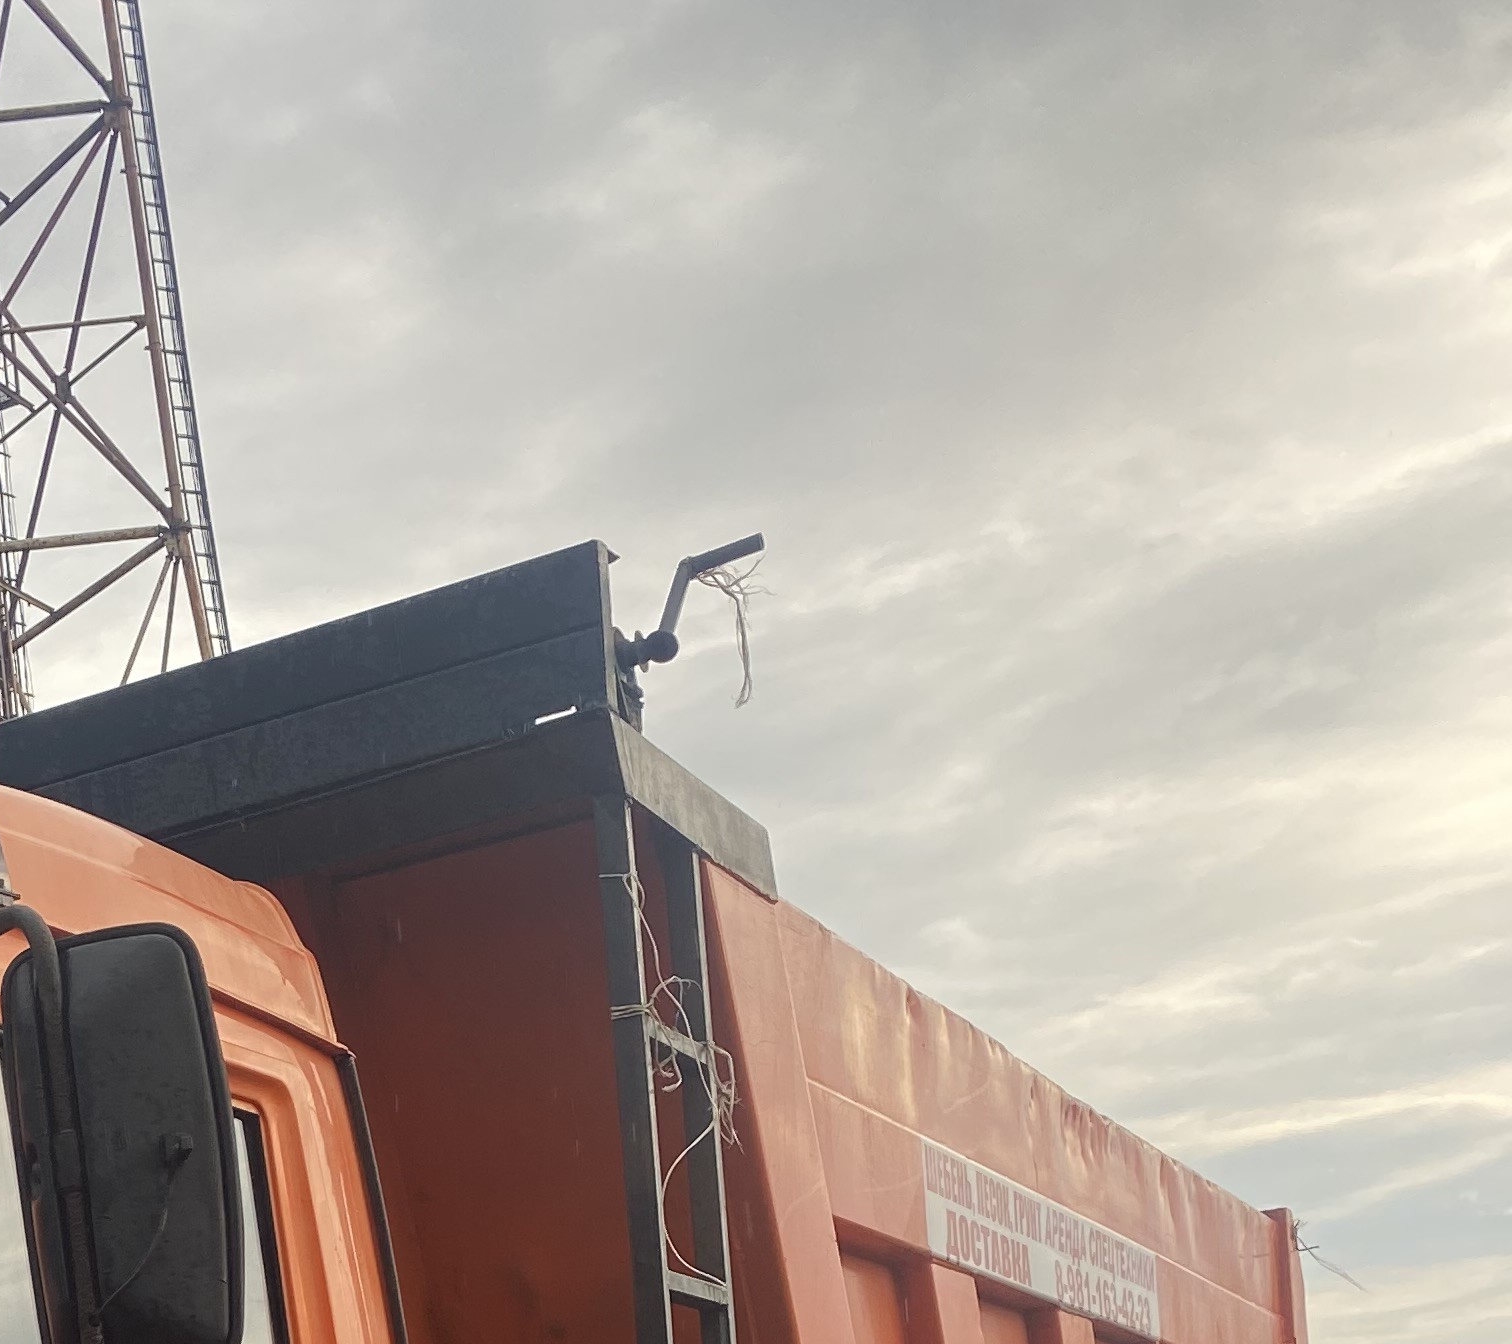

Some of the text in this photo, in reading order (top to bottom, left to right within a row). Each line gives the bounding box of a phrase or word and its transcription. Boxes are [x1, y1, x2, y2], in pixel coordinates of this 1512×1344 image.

[946, 1208, 1152, 1336] ДОСТАВКА 8-981-163-42-23
[975, 1170, 1013, 1234] ПЕСОК,
[1013, 1190, 1042, 1244] ГРУНТ
[1045, 1206, 1087, 1268] АРЕНДА
[1089, 1225, 1155, 1292] СПЕЦТЕХНИКИ
